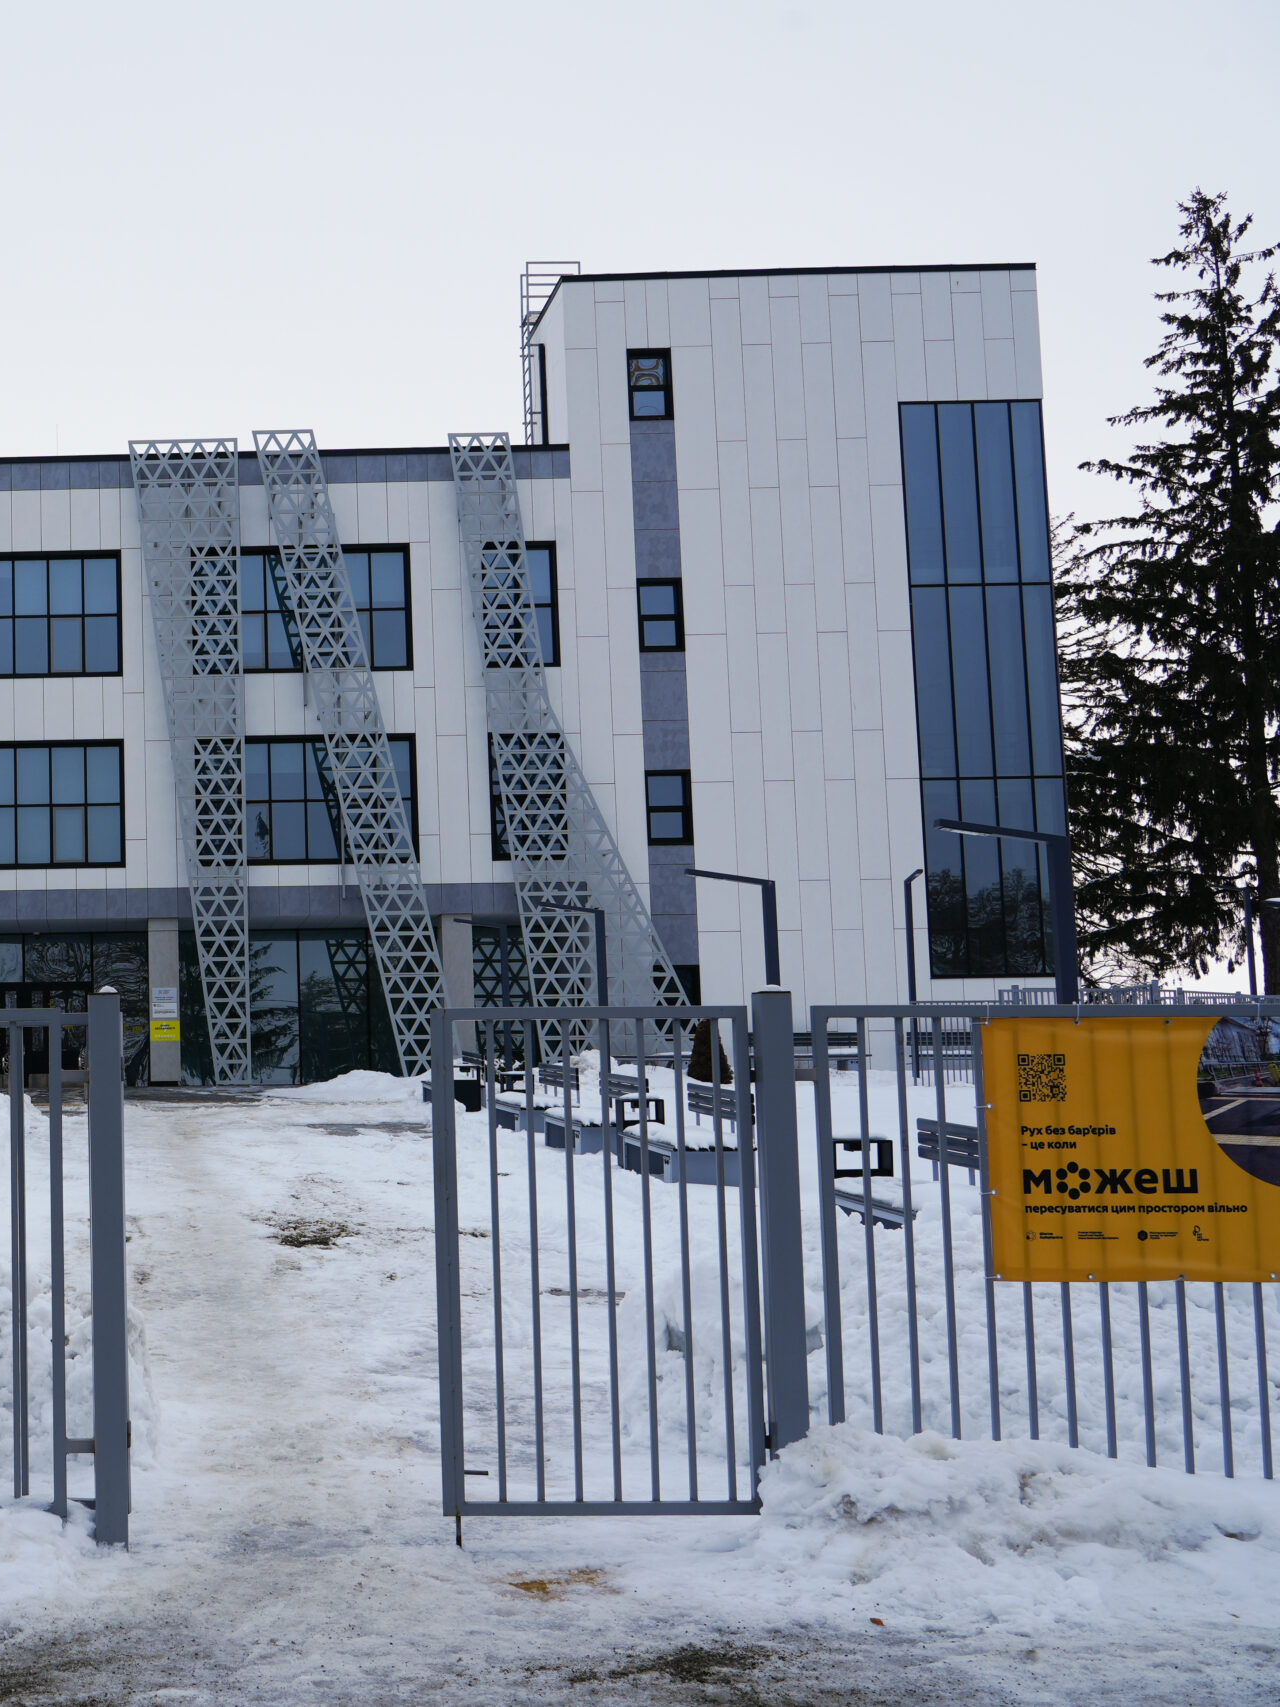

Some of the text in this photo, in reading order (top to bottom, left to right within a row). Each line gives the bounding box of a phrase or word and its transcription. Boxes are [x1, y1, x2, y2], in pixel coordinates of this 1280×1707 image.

[1020, 1125, 1043, 1138] Рух
[1044, 1125, 1066, 1136] без
[1030, 1141, 1045, 1151] це
[1047, 1141, 1077, 1150] коли
[1024, 1202, 1248, 1215] пересуватися цим простором вільно
